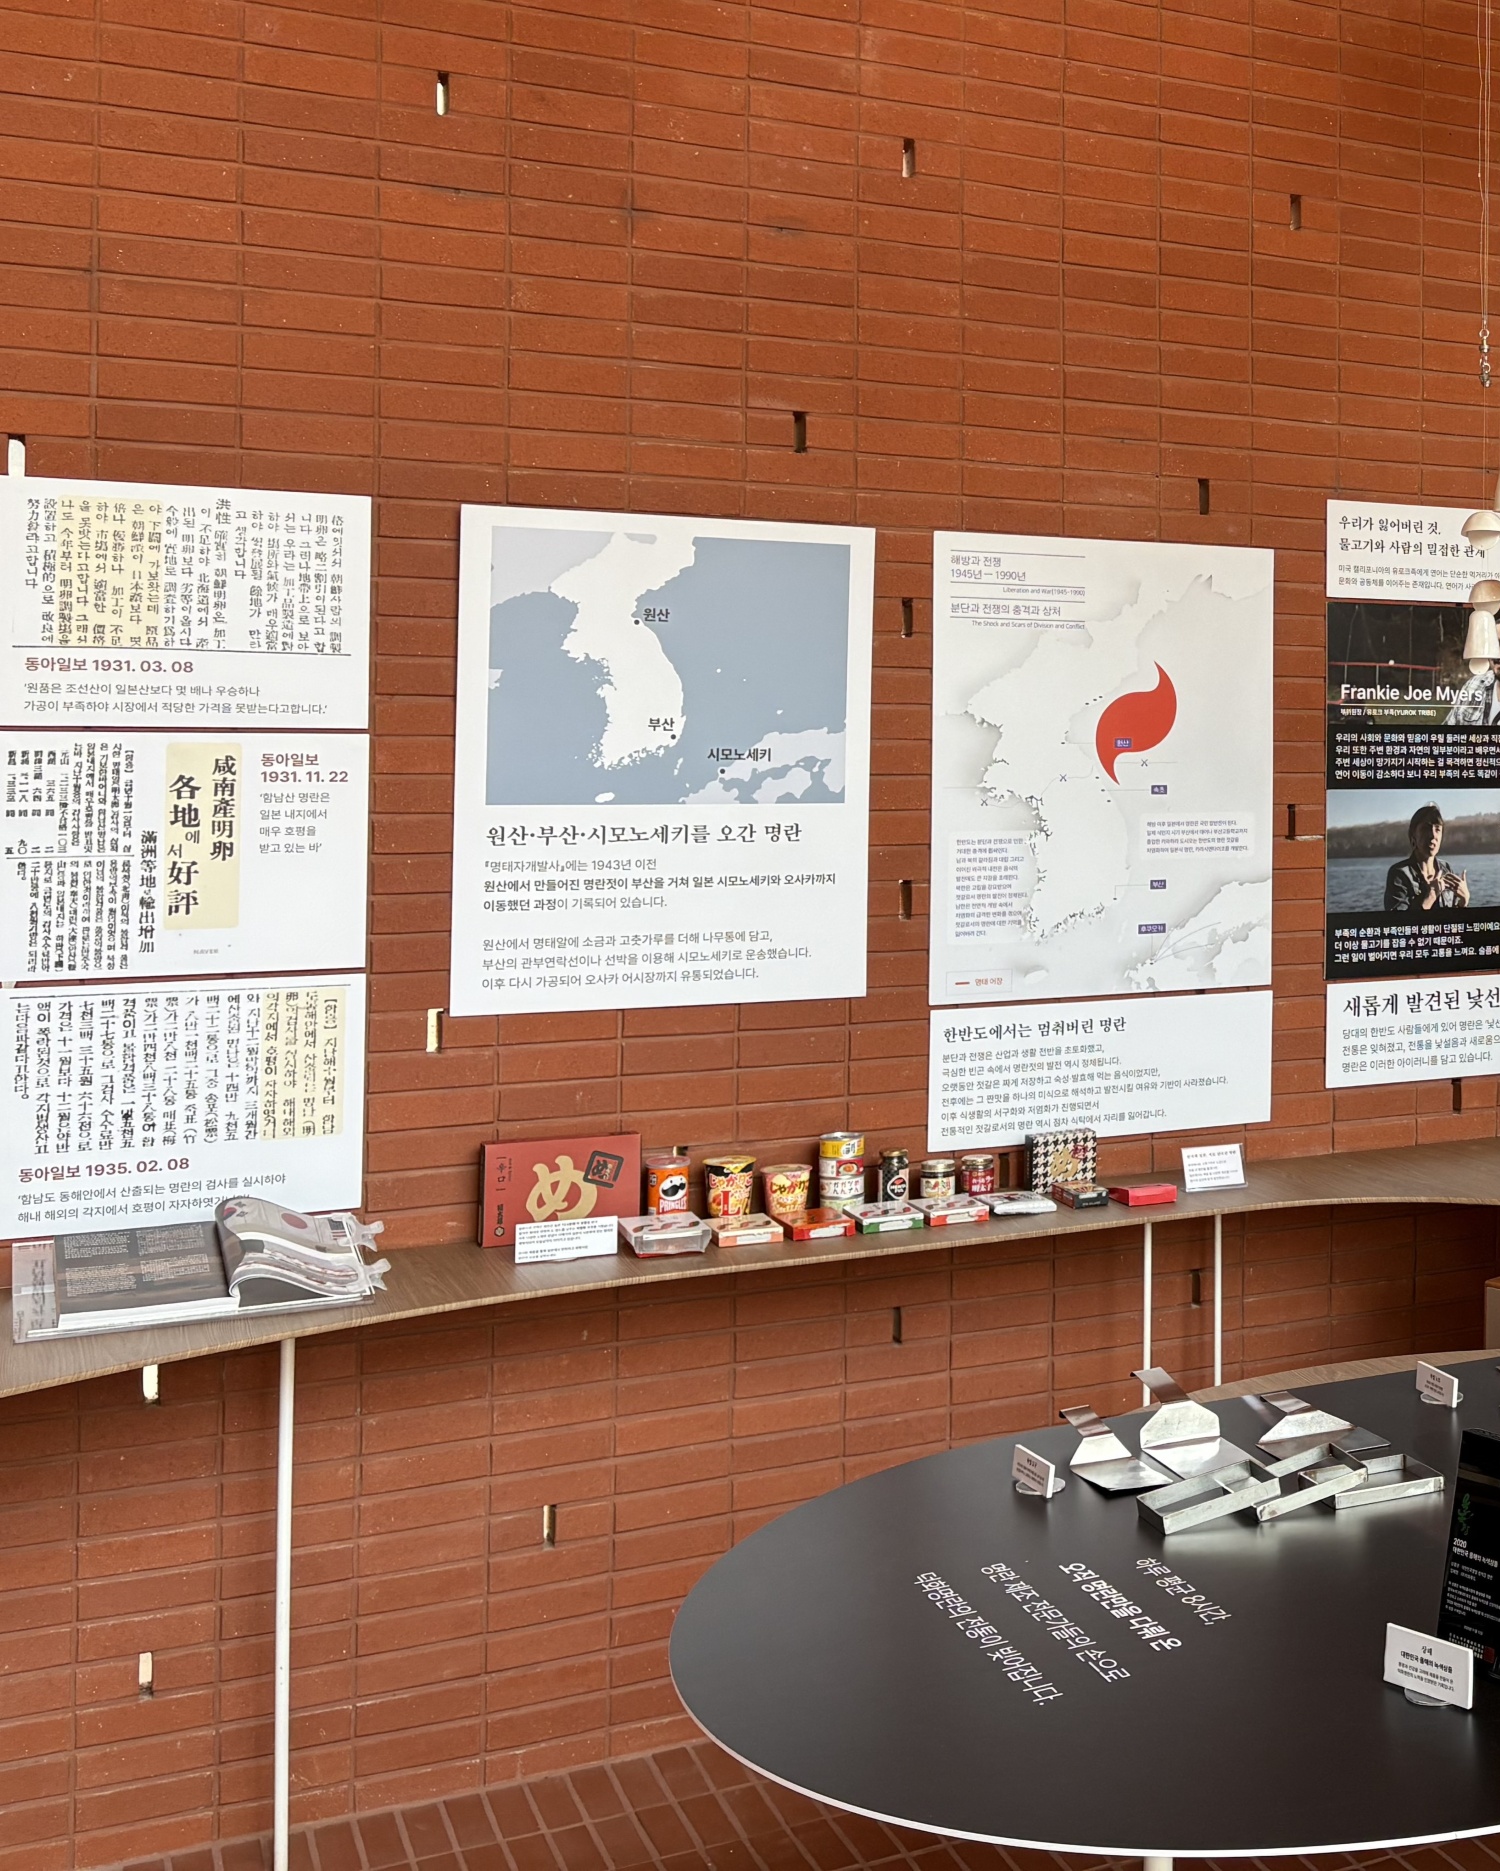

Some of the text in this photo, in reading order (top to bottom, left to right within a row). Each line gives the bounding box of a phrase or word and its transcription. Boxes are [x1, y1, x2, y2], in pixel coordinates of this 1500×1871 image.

[1339, 515, 1374, 531] 우리가
[1378, 518, 1423, 534] 잃어버린
[1339, 537, 1385, 554] 물고기와
[1389, 540, 1423, 556] 사람의
[1427, 542, 1461, 558] 밀접한
[950, 555, 1001, 568] 해방과 전쟁
[951, 568, 1026, 582] 1945년 1990년
[640, 607, 670, 625] 원산
[950, 602, 1061, 617] 분단과 전쟁의 충격과 상처
[1033, 621, 1054, 629] Division
[24, 657, 193, 673] 동아일보 1931. 03. 08
[1340, 683, 1483, 705] Frankie Joe Myers
[647, 717, 675, 732] 부산
[260, 753, 319, 767] 동아일보
[707, 747, 771, 764] 시모노세키
[260, 770, 348, 783] 1931. 11. 22
[259, 808, 327, 820] 일본 내지에서
[259, 825, 316, 837] 매우 호평을
[716, 823, 757, 843] 오간
[764, 822, 802, 843] 명란
[259, 843, 281, 854] 받고
[283, 843, 306, 854] 있는
[591, 858, 631, 871] 1943년
[634, 858, 656, 871] 이전
[1343, 993, 1398, 1018] 새롭게
[1406, 989, 1460, 1014] 발견된
[1466, 986, 1500, 1010] 낯선
[943, 1016, 1127, 1043] 한반도에서는 멈춰버린 명란
[18, 1157, 189, 1182] 동아일보 1935. 02. 08
[659, 1199, 687, 1213] PRINGLES
[1453, 1537, 1467, 1549] 2020
[1058, 1562, 1100, 1583] 오직
[1080, 1578, 1143, 1619] 명란만을
[1135, 1557, 1233, 1626] 하루 평균 8시간,
[980, 1562, 1131, 1683] 명란 제조 전문가들의 손으로
[913, 1571, 1064, 1706] 덕화명란의 전통이 빚어집니다.
